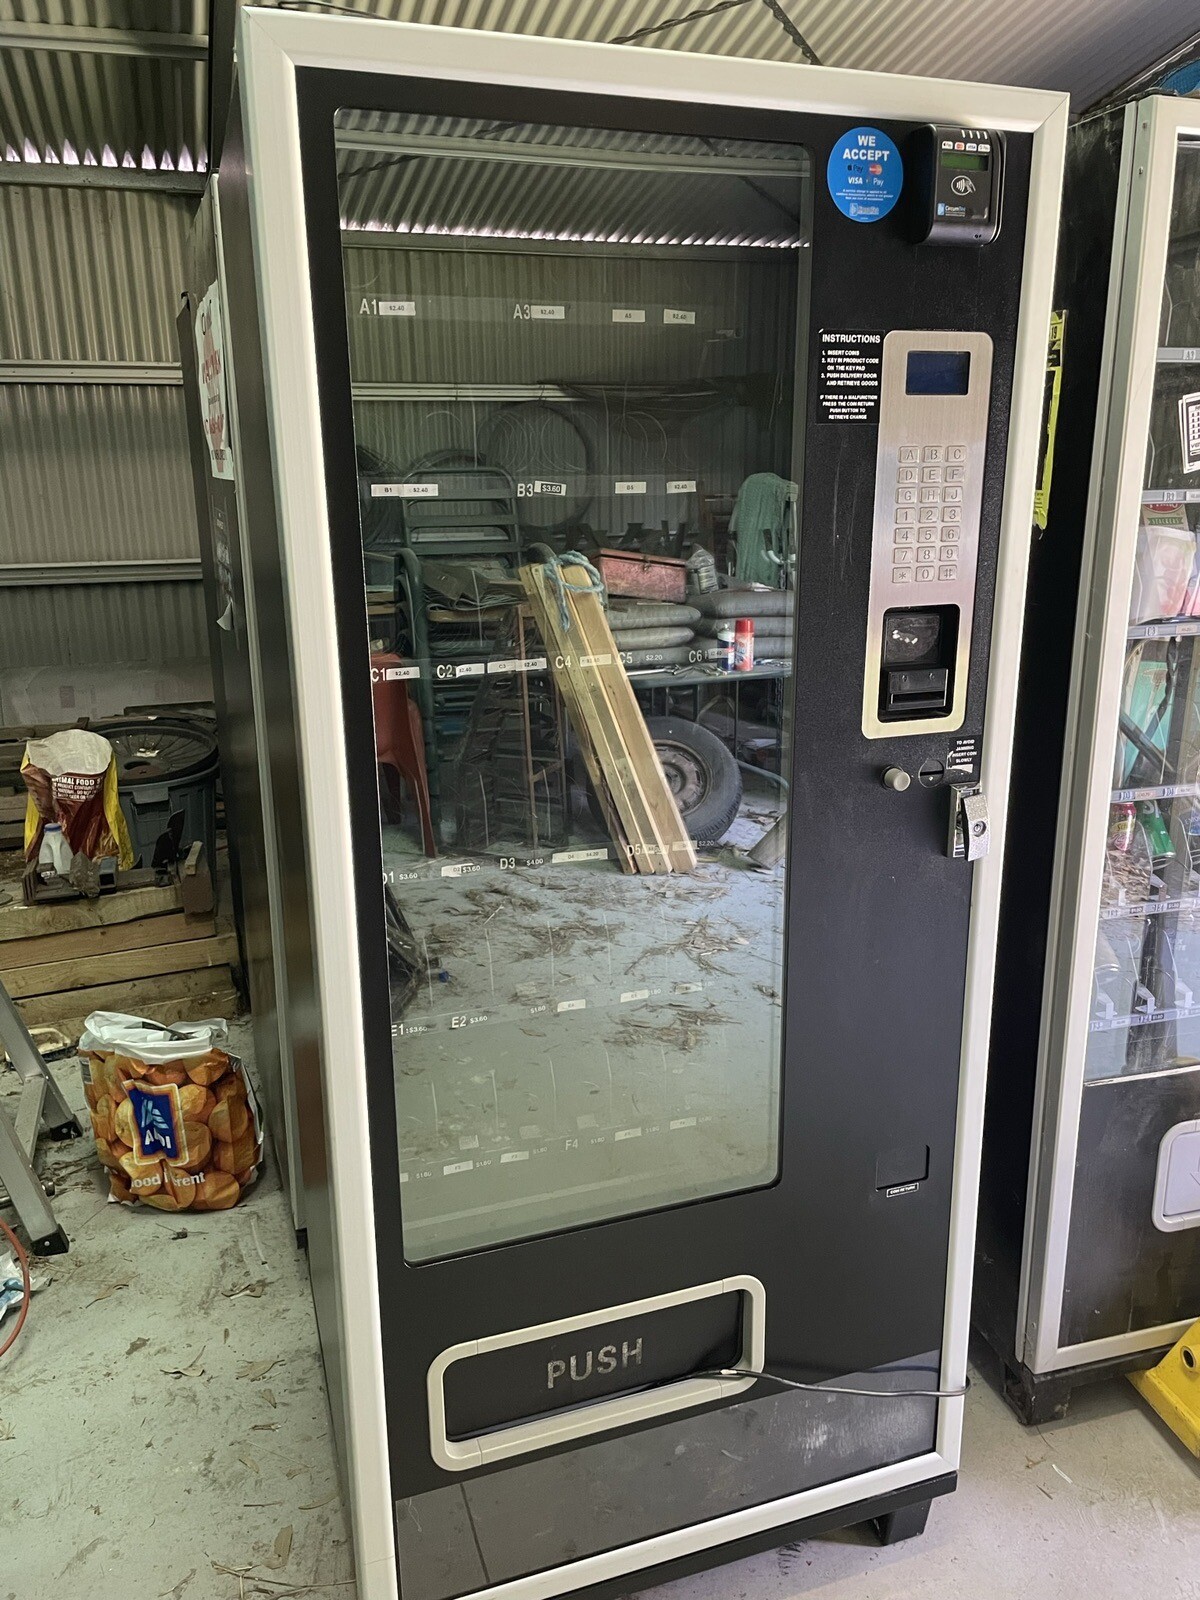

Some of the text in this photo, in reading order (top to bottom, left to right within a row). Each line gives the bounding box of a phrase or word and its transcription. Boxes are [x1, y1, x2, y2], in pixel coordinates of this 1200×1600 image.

[857, 134, 876, 147] WE
[842, 148, 890, 162] ACCEPT
[848, 176, 863, 184] VISA
[873, 178, 885, 188] Pay
[360, 298, 377, 314] A1
[514, 304, 530, 320] A3
[822, 334, 880, 344] INSTRUCTIONS
[906, 450, 914, 460] A
[930, 450, 938, 460] B
[954, 449, 961, 459] C
[905, 470, 912, 480] D
[929, 470, 935, 480] E
[952, 469, 960, 479] F
[517, 483, 561, 497] B3 $3.60
[927, 490, 934, 500] H
[951, 490, 958, 500] J
[905, 491, 911, 501] G
[904, 511, 908, 521] 1
[926, 510, 933, 520] 2
[950, 510, 956, 520] 3
[902, 531, 908, 541] 4
[925, 530, 932, 540] 5
[948, 529, 954, 539] 6
[901, 551, 907, 560] 7
[924, 550, 930, 560] 8
[946, 549, 953, 559] 9
[922, 569, 929, 579] 0
[944, 568, 952, 578] #
[619, 652, 633, 664] C5
[688, 650, 702, 663] C6
[556, 655, 571, 669] C4
[370, 668, 385, 682] C1
[437, 664, 453, 678] C2
[627, 844, 640, 856] D5
[500, 858, 516, 869] D3
[452, 1016, 466, 1028] E2
[392, 1024, 404, 1037] E1
[566, 1138, 579, 1150] F4
[546, 1337, 643, 1390] PUSH
